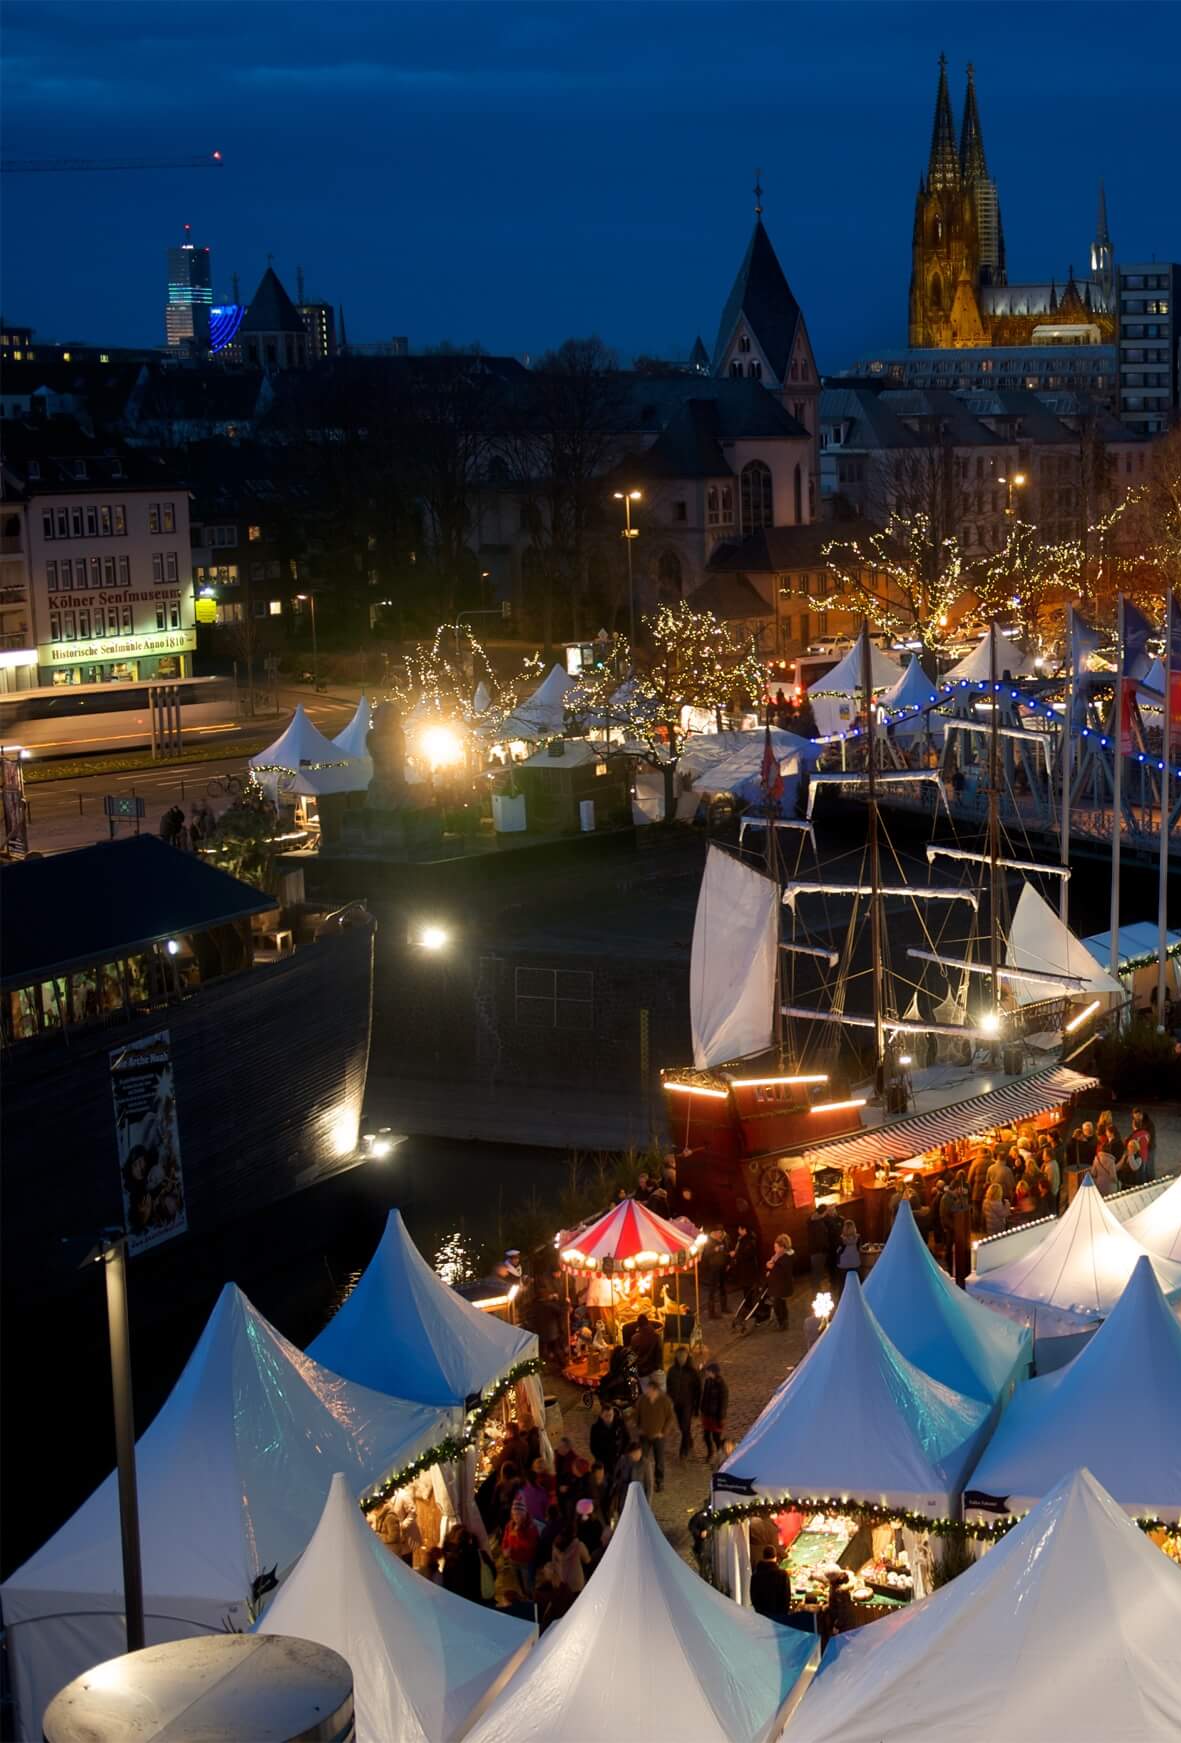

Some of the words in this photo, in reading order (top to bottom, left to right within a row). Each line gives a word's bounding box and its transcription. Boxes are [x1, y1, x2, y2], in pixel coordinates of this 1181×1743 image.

[48, 594, 95, 610] Kölner
[99, 589, 181, 605] Senfmuseum
[52, 647, 98, 660] Historische
[143, 639, 165, 650] Anno
